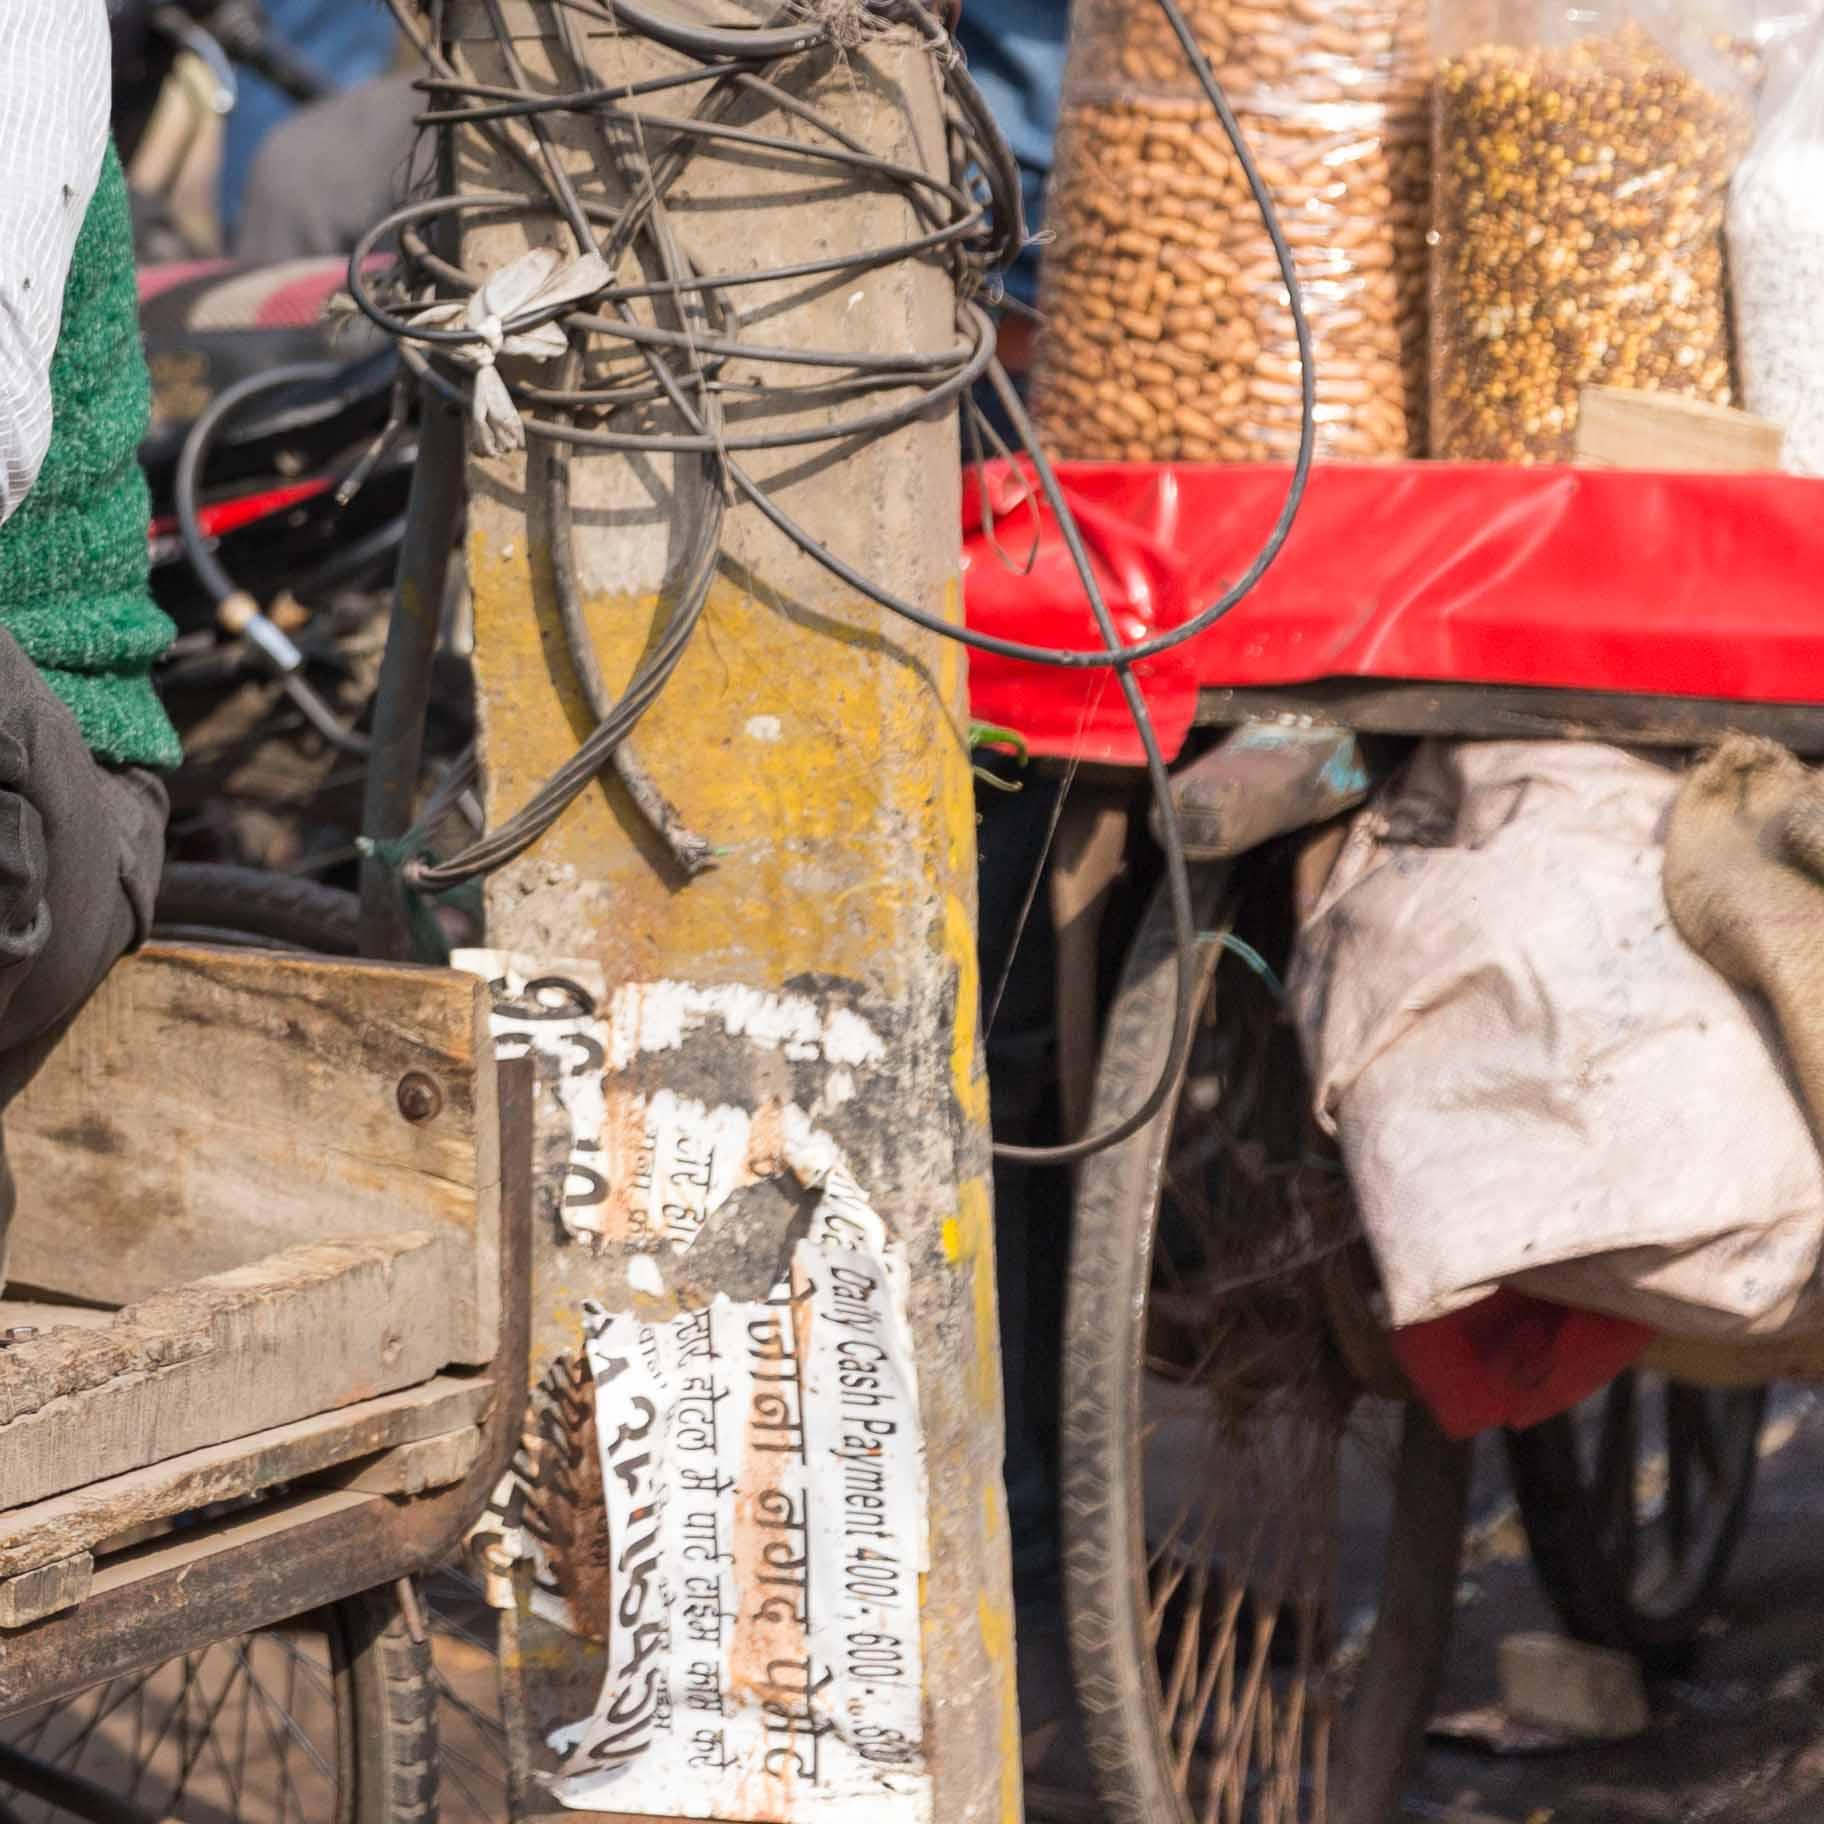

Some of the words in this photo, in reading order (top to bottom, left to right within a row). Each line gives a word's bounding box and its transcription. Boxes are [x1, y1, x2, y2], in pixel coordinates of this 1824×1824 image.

[820, 1267, 885, 1332] Daily
[836, 1340, 897, 1408] Cash
[830, 1417, 897, 1538] Payment
[753, 1488, 811, 1636] नगद
